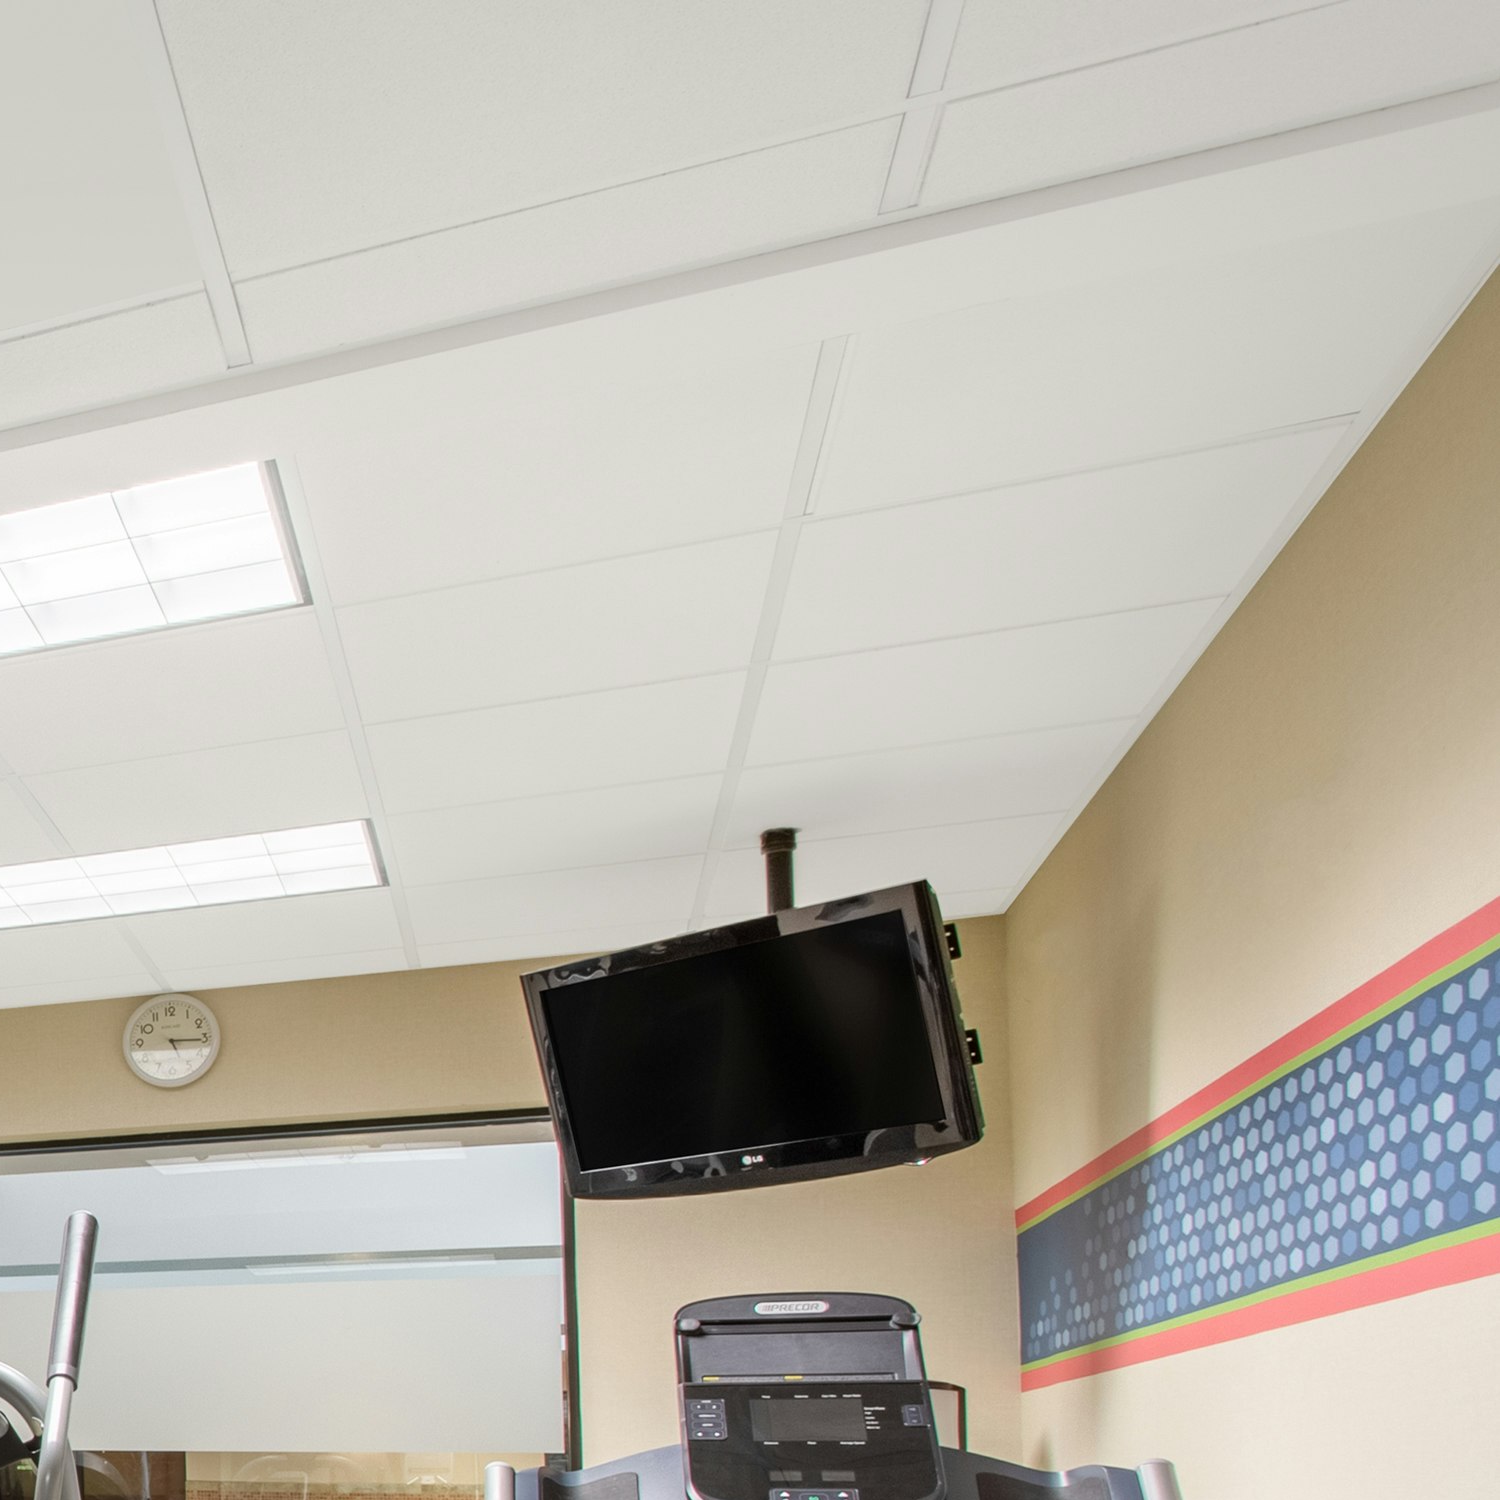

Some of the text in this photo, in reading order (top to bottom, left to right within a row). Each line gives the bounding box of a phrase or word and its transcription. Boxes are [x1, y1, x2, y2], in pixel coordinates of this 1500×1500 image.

[164, 1006, 176, 1016] 12
[152, 1012, 158, 1022] 11
[140, 1023, 154, 1034] 10
[194, 1018, 203, 1029] 2
[136, 1038, 144, 1048] 9
[201, 1033, 208, 1043] 3
[142, 1052, 149, 1062] 8
[771, 1303, 819, 1312] PRECOR
